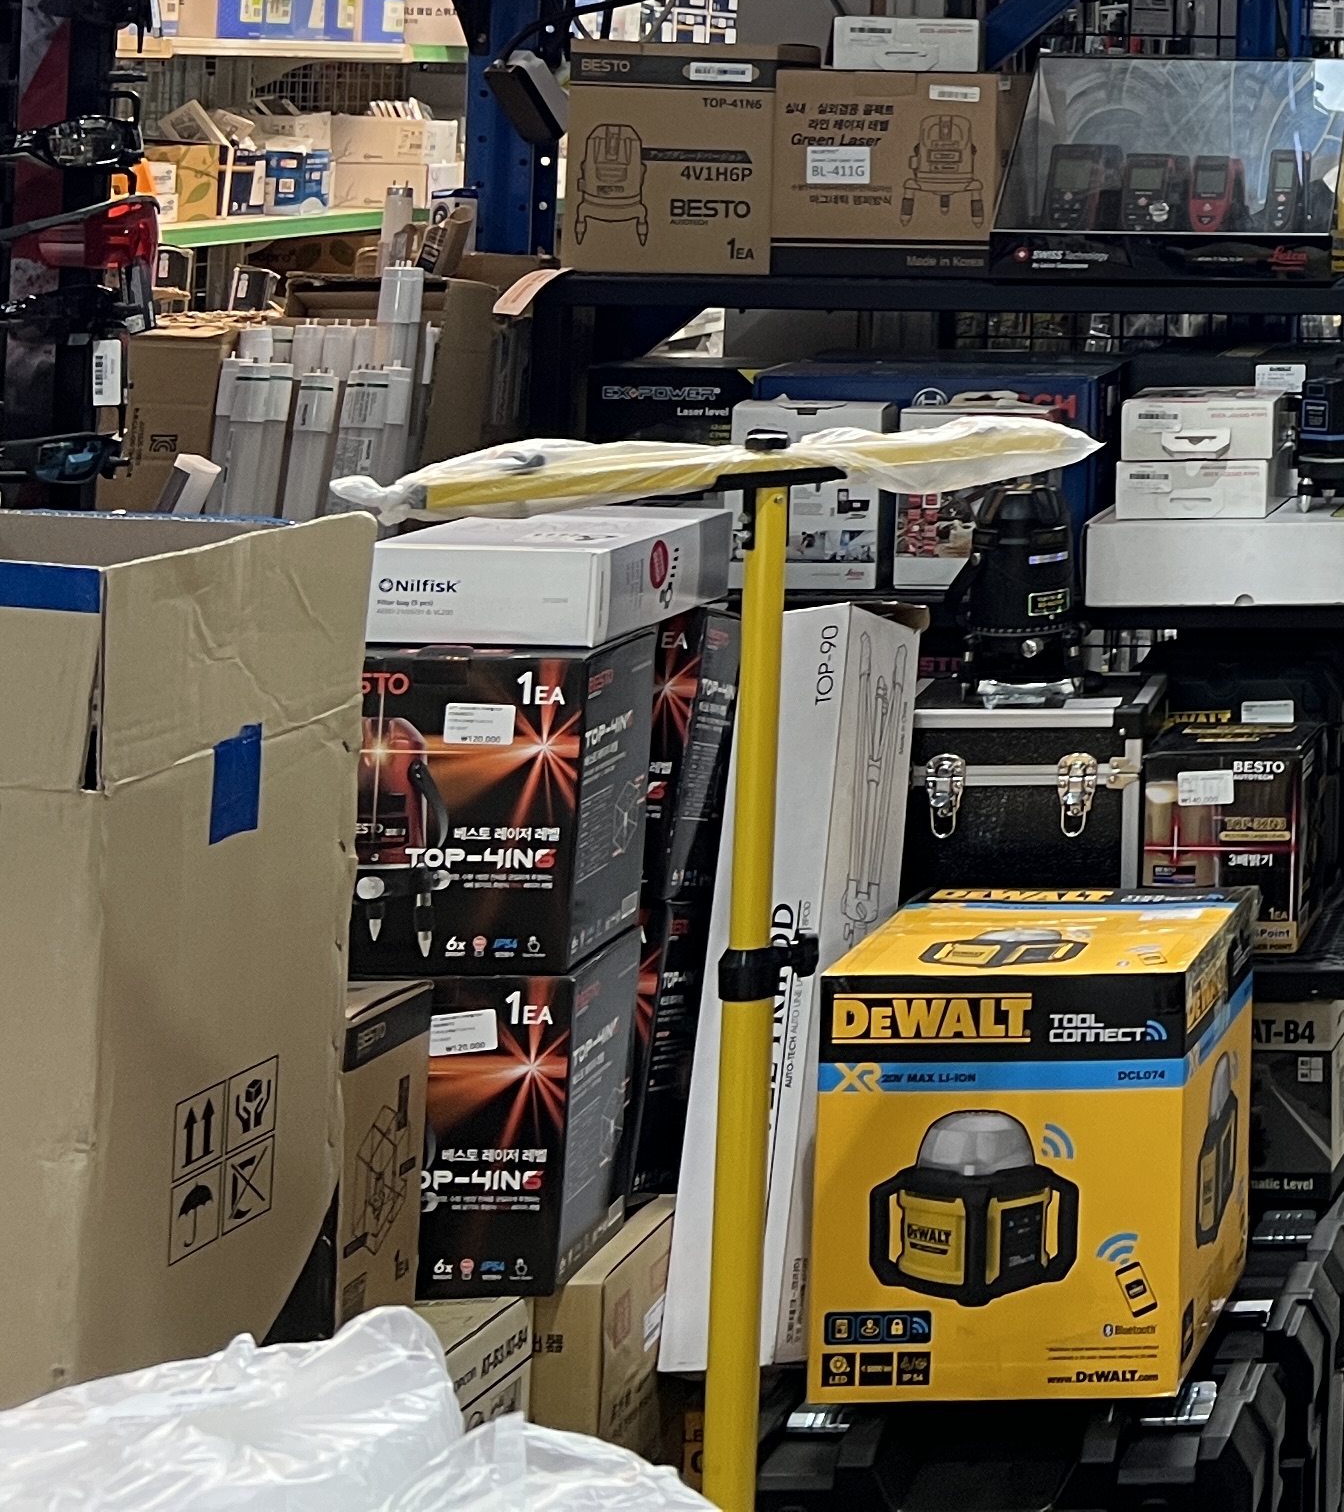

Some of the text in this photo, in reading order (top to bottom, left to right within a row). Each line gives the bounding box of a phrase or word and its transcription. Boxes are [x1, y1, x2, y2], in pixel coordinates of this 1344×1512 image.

[581, 58, 631, 73] BESTO
[790, 132, 882, 148] Green Laser
[680, 164, 754, 183] 4V1H6P
[811, 164, 866, 178] BL-411G
[668, 198, 752, 219] BESTO
[676, 406, 730, 417] Laser level
[395, 579, 459, 594] Nilfisk
[661, 631, 688, 650] EA
[815, 624, 840, 707] TOP-90
[361, 672, 410, 696] STO
[1233, 760, 1285, 774] BESTO
[453, 827, 561, 842] 베스트 레이저 레벨
[832, 998, 1033, 1039] DEWALT
[1049, 1013, 1105, 1028] TOOL
[1049, 1028, 1146, 1043] CONNECT
[784, 1035, 798, 1089] AUTO-TECH
[906, 1073, 937, 1084] MAX
[938, 1072, 977, 1083] LI-ION
[1117, 1069, 1166, 1081] DCL074
[441, 1148, 480, 1163] 베스트
[481, 1148, 520, 1163] 레이저
[1250, 1177, 1314, 1191] matic Level
